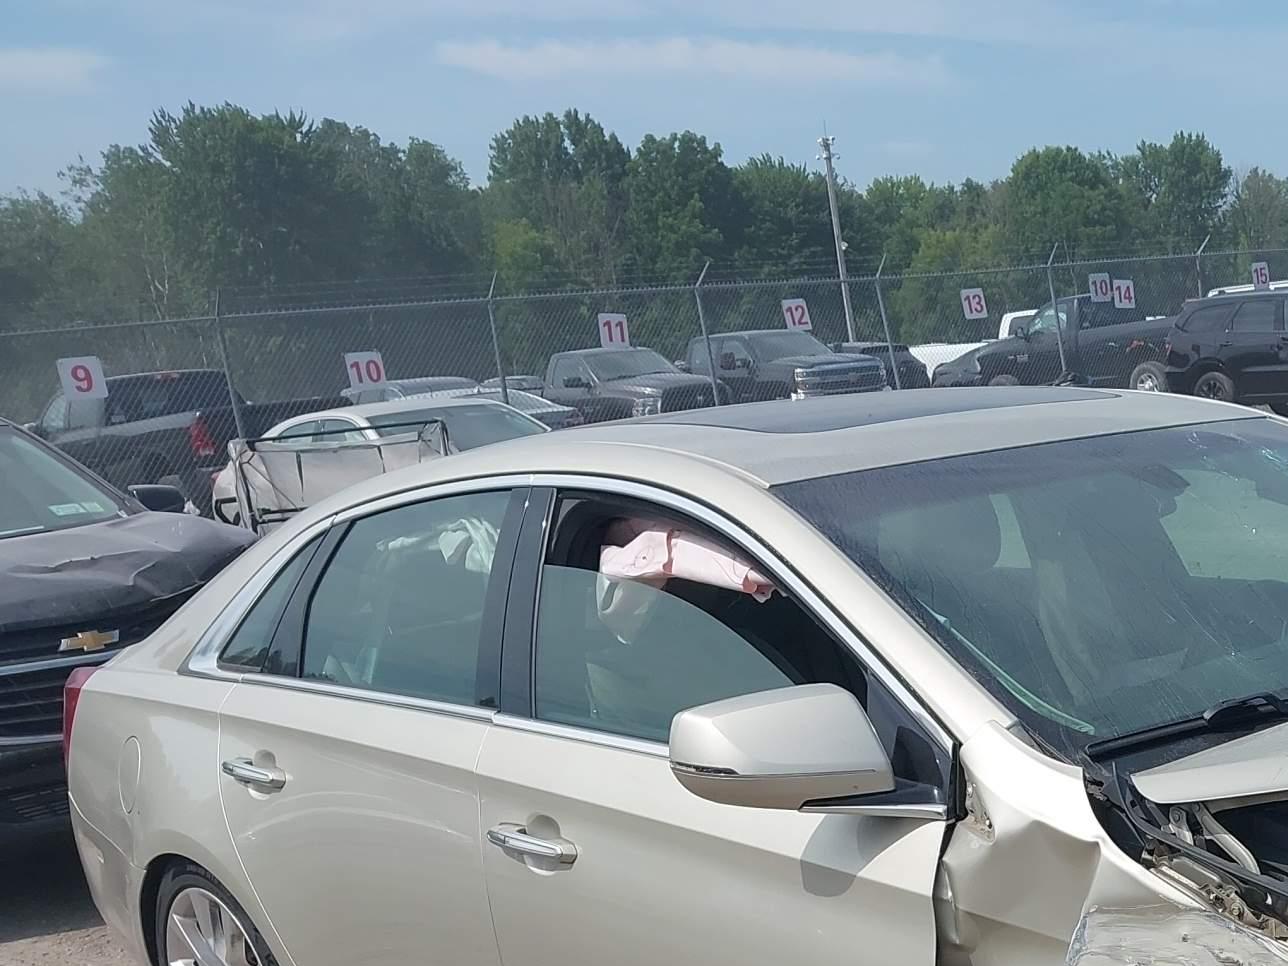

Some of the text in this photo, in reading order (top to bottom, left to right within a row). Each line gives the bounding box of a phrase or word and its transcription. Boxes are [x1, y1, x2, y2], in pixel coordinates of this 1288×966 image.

[1253, 267, 1268, 284] 15
[1091, 279, 1108, 297] 10
[1115, 285, 1133, 304] 14
[964, 294, 984, 314] 13
[785, 304, 809, 326] 12
[602, 320, 626, 343] 11
[70, 365, 94, 393] 9
[349, 359, 382, 385] 10
